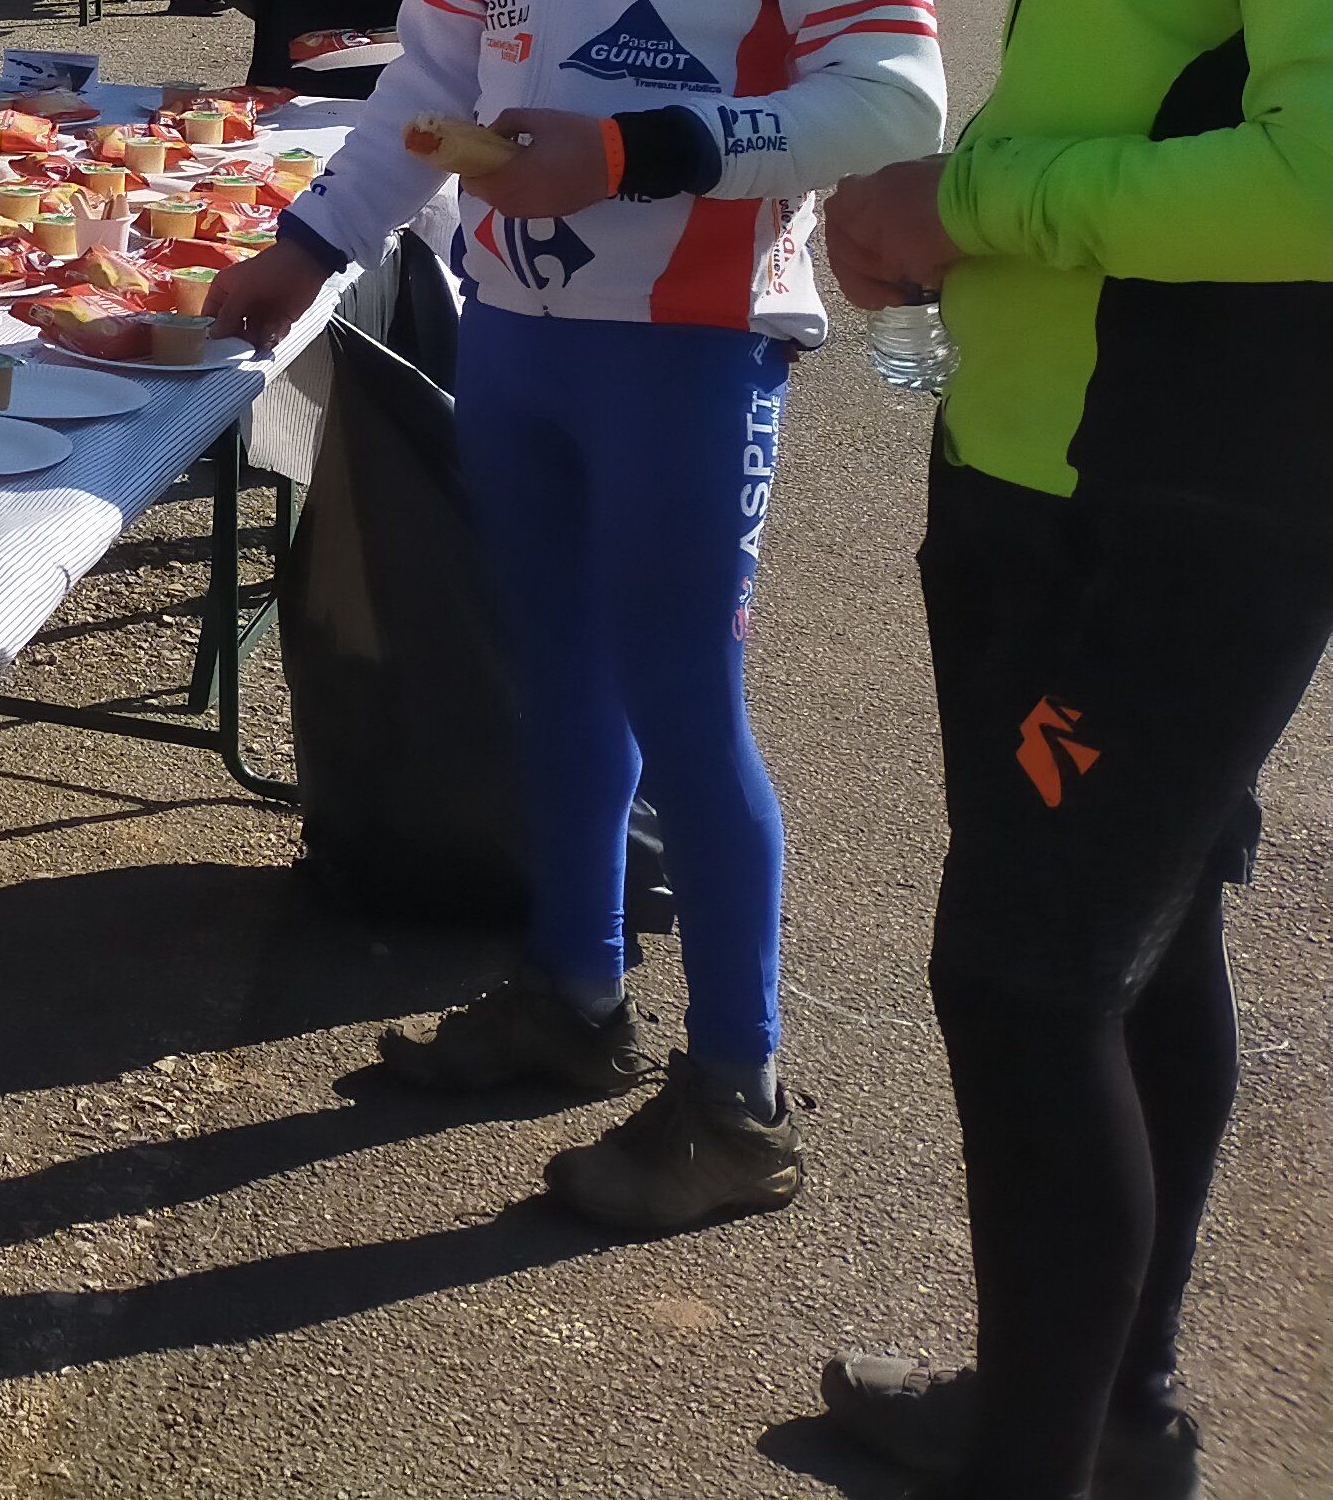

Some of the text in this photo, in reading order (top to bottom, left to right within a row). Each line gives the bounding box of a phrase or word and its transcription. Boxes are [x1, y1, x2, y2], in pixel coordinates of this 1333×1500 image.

[617, 33, 674, 50] Pascal
[590, 43, 691, 71] GUINOT
[632, 78, 723, 94] Travaux Publics
